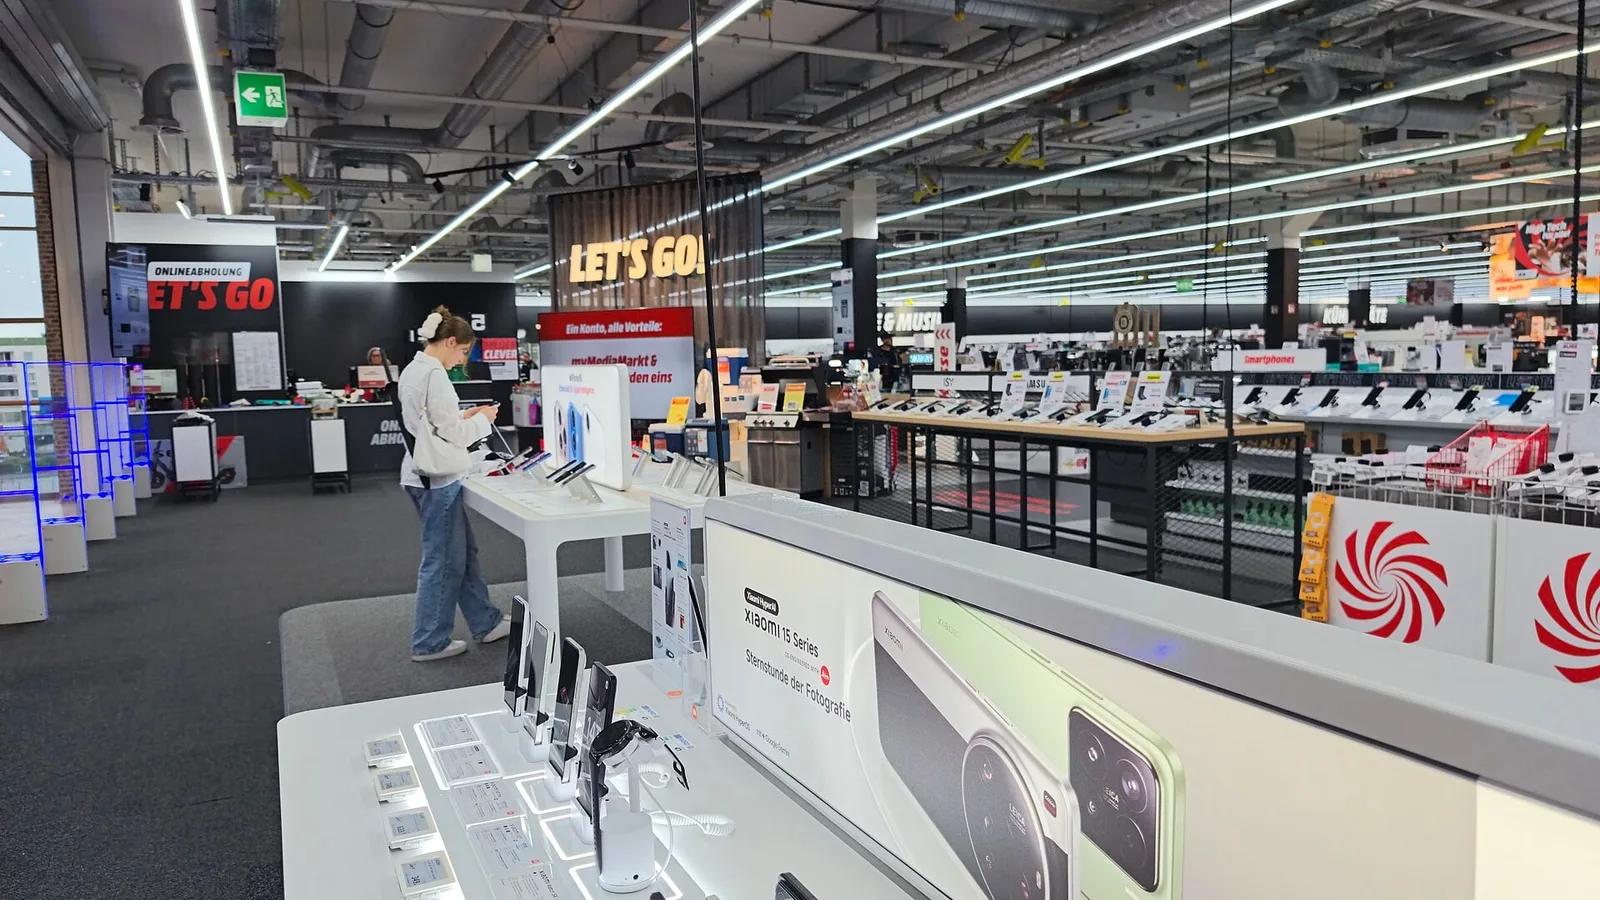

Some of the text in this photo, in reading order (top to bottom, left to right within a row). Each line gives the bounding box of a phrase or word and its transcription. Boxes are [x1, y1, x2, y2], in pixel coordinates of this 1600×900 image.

[569, 234, 707, 282] LET'S GO!
[154, 266, 243, 277] ONLINEABHOLUNG
[147, 277, 275, 310] ET'S GO
[566, 321, 663, 335] Ein Konto, alle Vorteile:
[883, 312, 894, 333] &
[483, 349, 517, 360] CLEVER
[651, 355, 657, 366] &
[1244, 355, 1295, 365] Smartphones
[651, 372, 672, 383] eins
[746, 591, 760, 606] Xiaomi
[782, 626, 791, 644] 15
[793, 632, 819, 658] Series
[745, 649, 851, 722] Sternstunde der Fotografie
